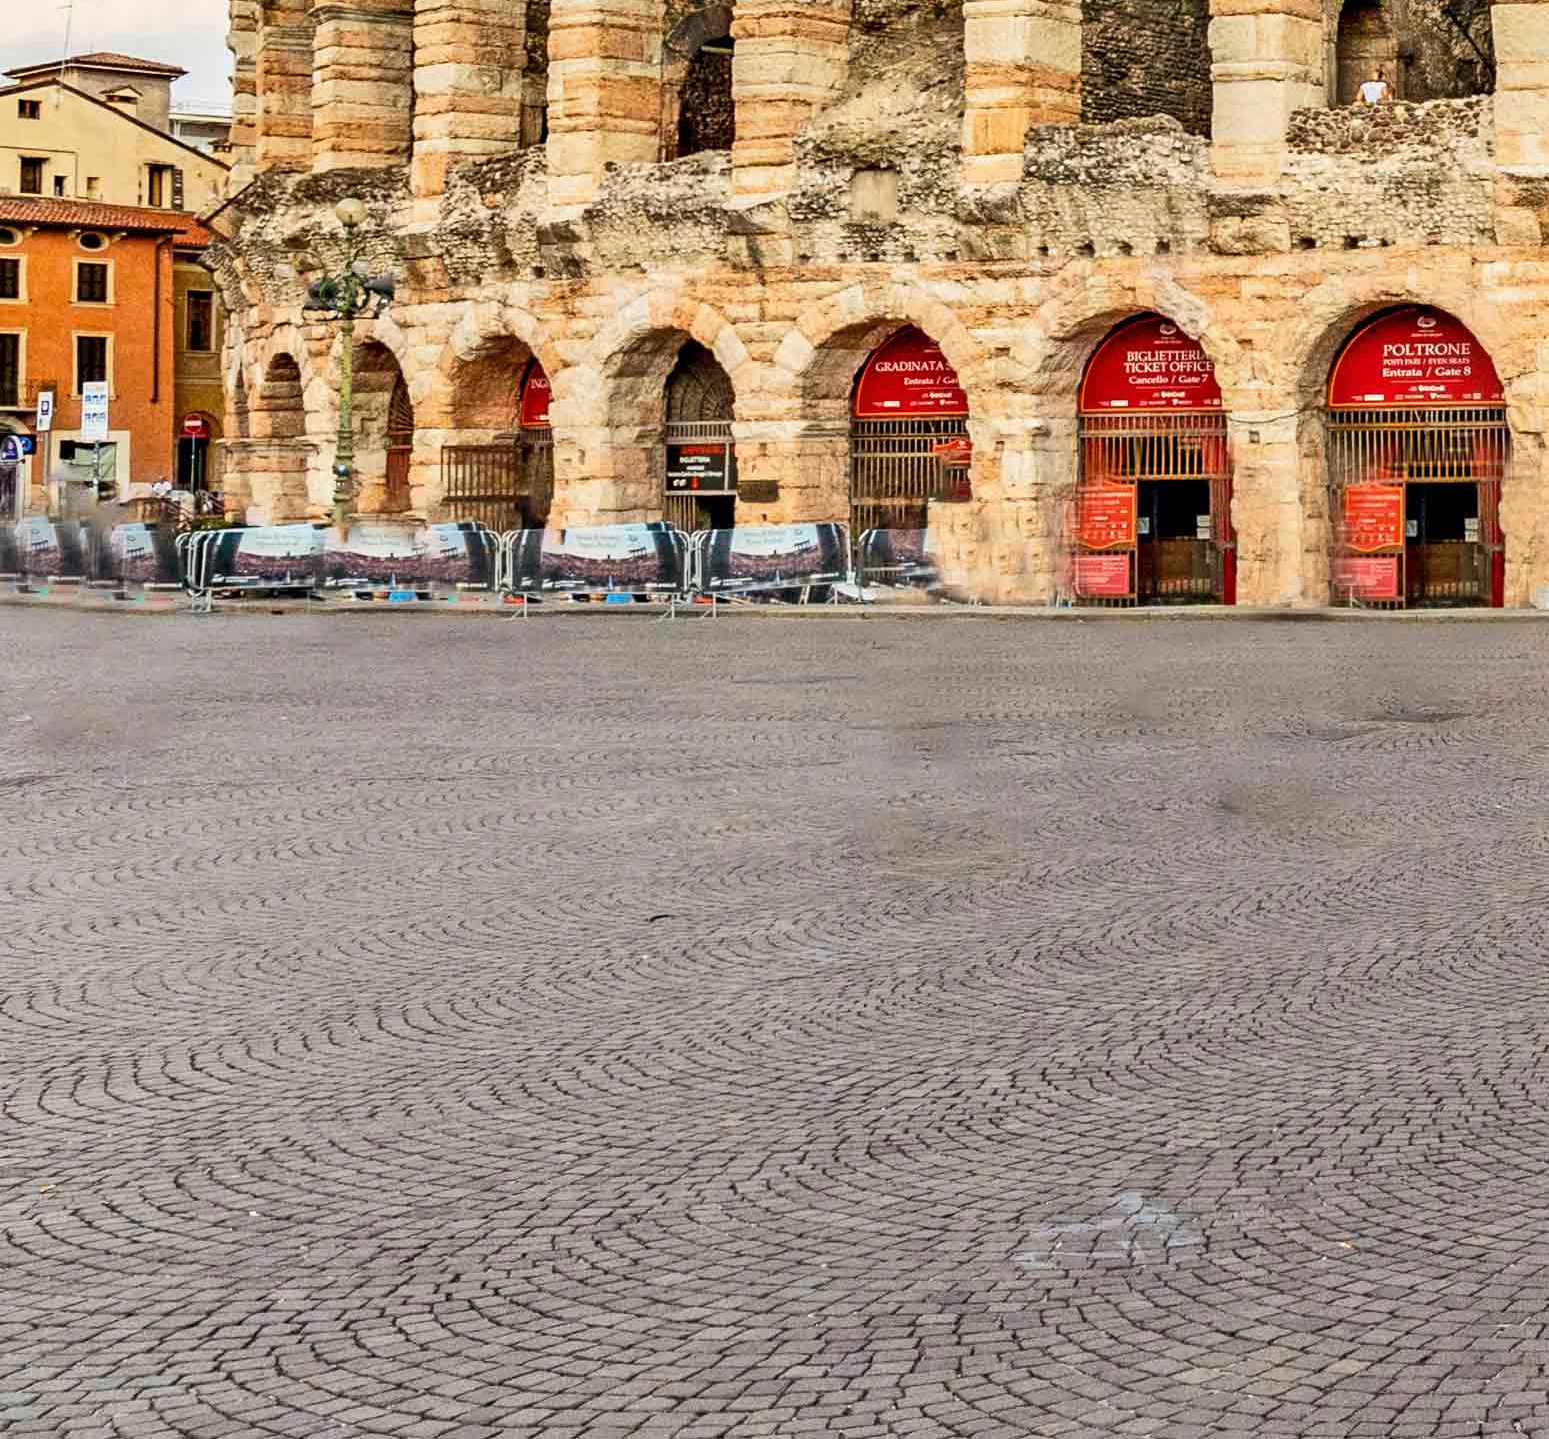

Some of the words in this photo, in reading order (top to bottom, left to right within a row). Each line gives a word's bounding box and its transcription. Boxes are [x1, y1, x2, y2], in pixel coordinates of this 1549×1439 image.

[1383, 343, 1471, 357] POLTRONE
[875, 361, 944, 373] GRADINATA
[1124, 361, 1167, 373] TICKET
[1170, 361, 1215, 372] OFFICE
[1382, 368, 1423, 378] Entrata
[1435, 366, 1461, 377] Gate
[1463, 366, 1471, 377] 8
[904, 377, 934, 386] Entrata
[943, 376, 959, 385] Ga
[1128, 375, 1169, 385] Cancello
[1178, 375, 1201, 384] Gate
[1201, 374, 1209, 383] 7
